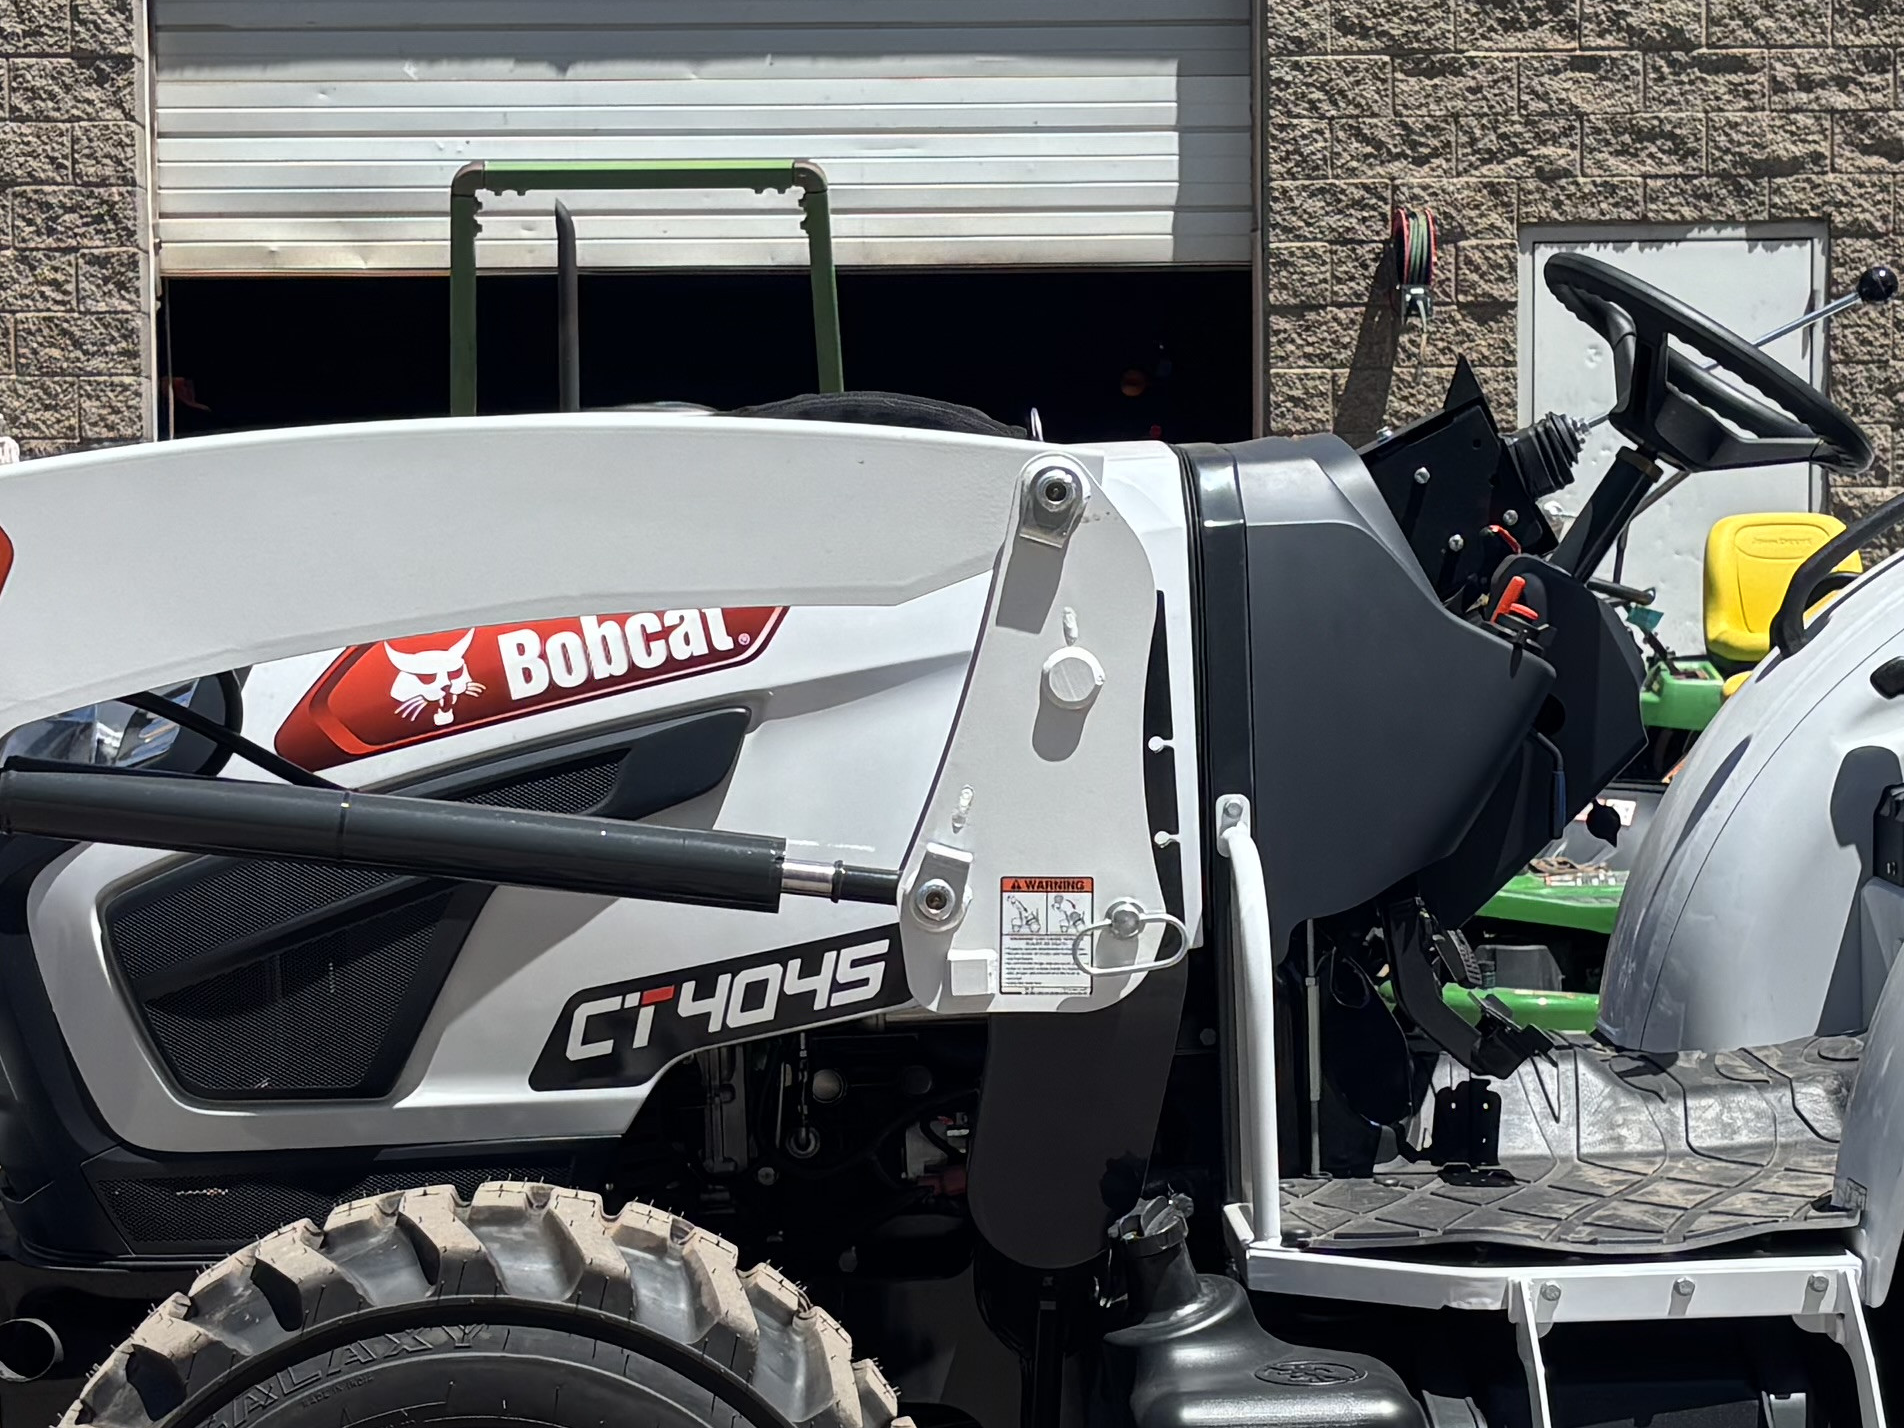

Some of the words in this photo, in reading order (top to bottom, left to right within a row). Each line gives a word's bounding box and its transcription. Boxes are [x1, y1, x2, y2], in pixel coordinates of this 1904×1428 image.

[497, 607, 735, 701] Bobcat
[1023, 879, 1086, 891] WARNING
[565, 938, 891, 1063] CT4045
